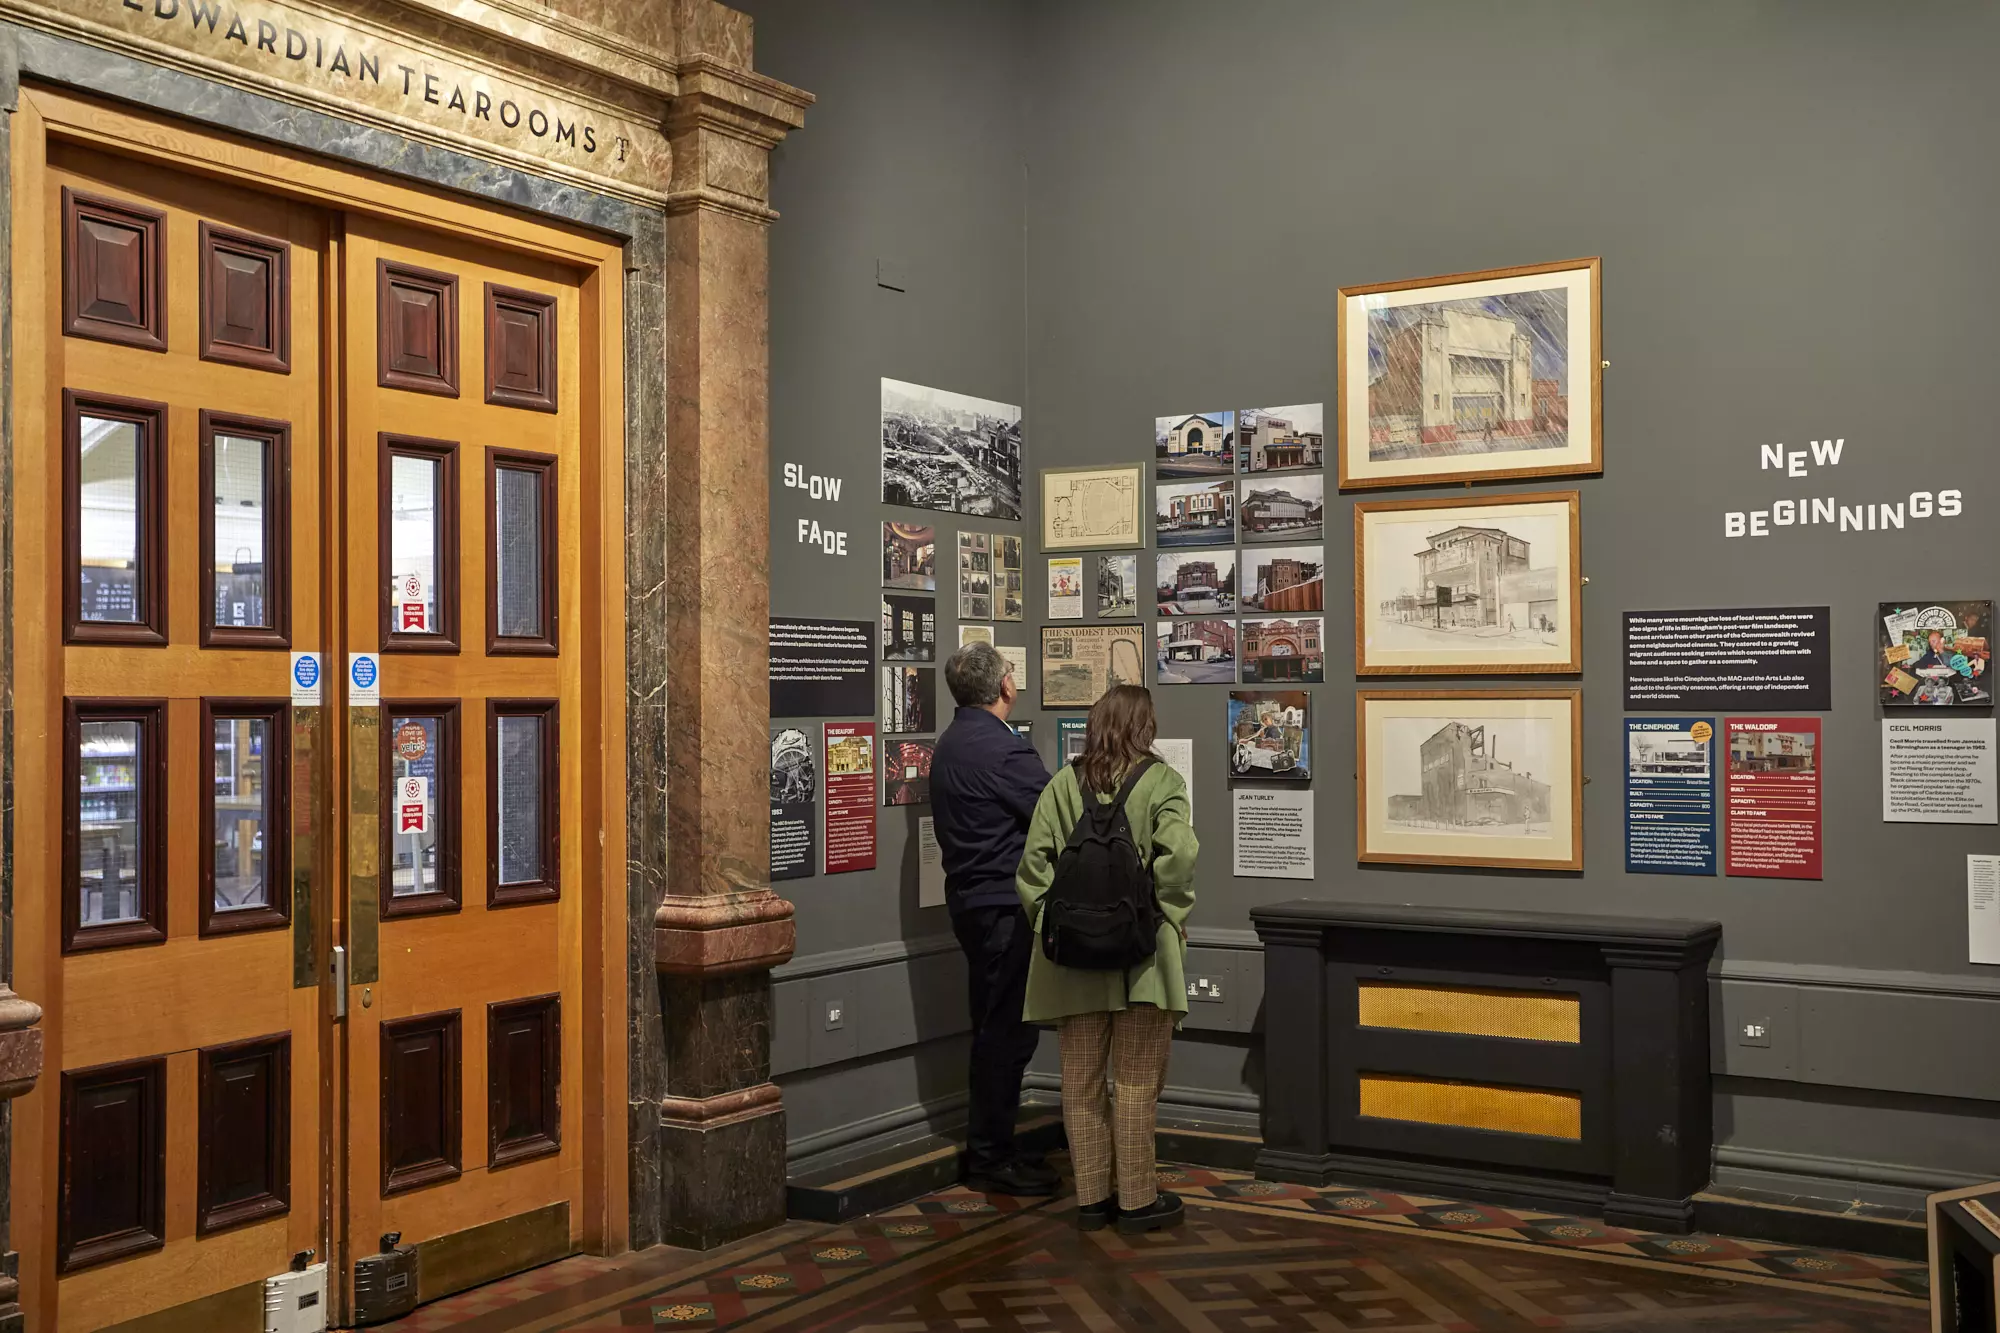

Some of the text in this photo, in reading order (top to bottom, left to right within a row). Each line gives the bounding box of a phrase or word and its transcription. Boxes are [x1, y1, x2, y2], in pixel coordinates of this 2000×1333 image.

[398, 64, 596, 153] TEAROOMS
[1761, 438, 1844, 478] NEW
[784, 462, 842, 502] SLOW
[1725, 489, 1962, 538] BEGINNINGS
[798, 518, 848, 556] FADE
[1064, 628, 1105, 637] SADDEST
[1108, 627, 1143, 636] ENDING
[1918, 610, 1939, 626] RISING
[1939, 610, 1953, 626] STAR
[401, 742, 417, 753] yelp
